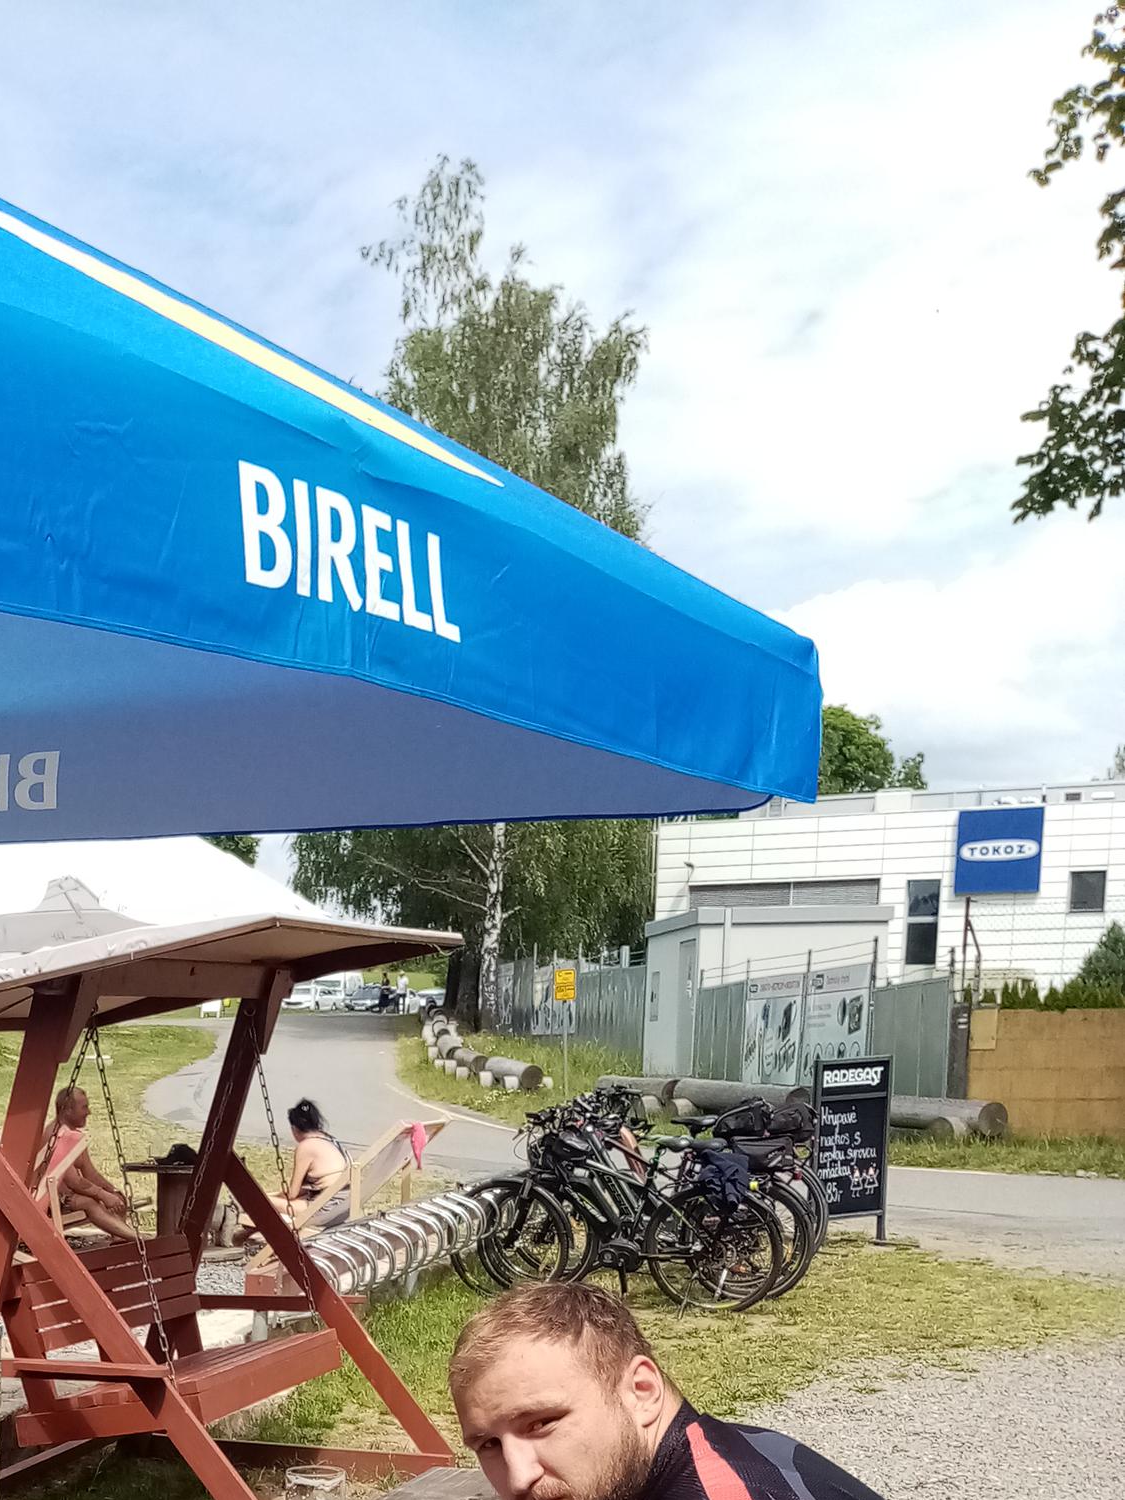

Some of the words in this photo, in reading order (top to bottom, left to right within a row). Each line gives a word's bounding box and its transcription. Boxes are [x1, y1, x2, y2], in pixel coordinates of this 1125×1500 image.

[238, 460, 461, 643] BIRELL
[967, 844, 1026, 857] TOKOZ
[823, 1066, 884, 1087] RADEGAST
